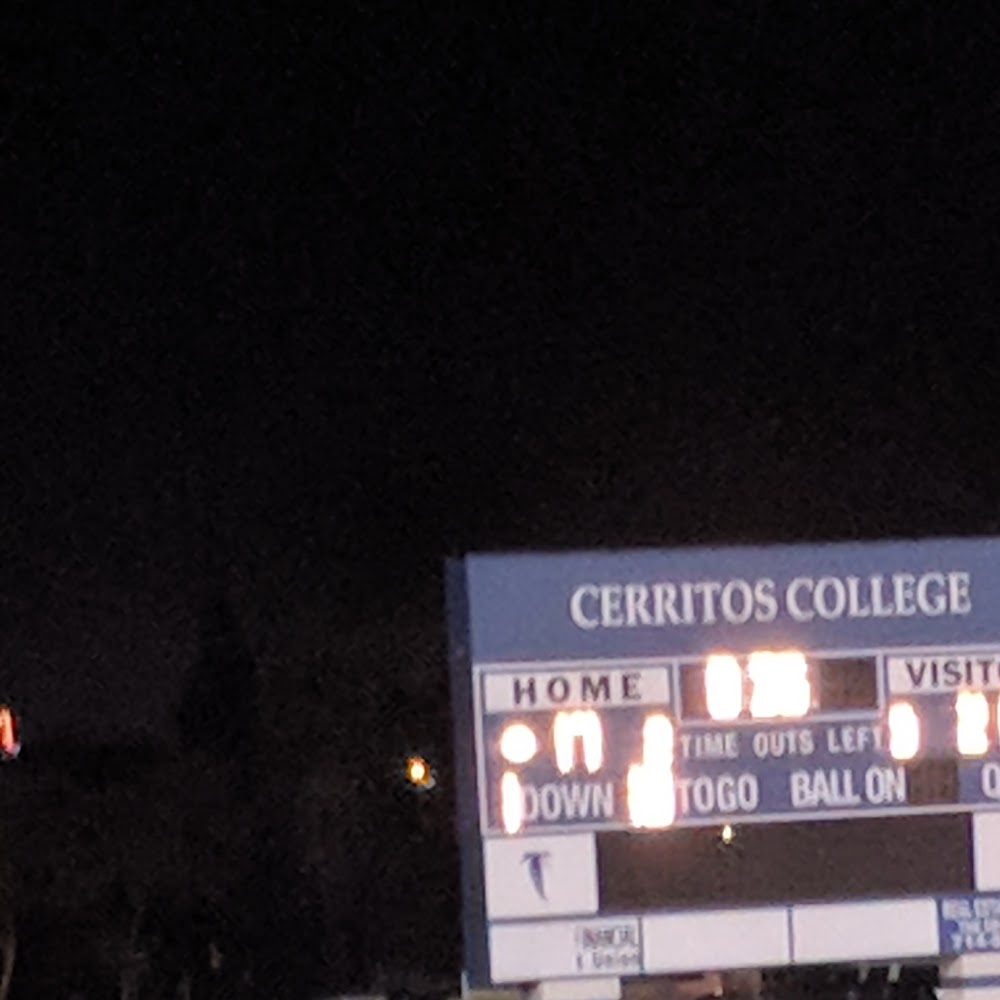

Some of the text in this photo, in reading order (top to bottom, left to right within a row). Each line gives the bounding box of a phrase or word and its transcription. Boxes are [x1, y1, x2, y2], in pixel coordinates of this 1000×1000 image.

[570, 571, 972, 629] CERRITOS COLLEGE
[513, 673, 642, 704] HOME
[681, 732, 738, 758] TIME
[753, 728, 814, 757] OUTS
[827, 724, 882, 753] LEFT
[523, 781, 614, 821] DOWN
[790, 763, 907, 808] BALL ON
